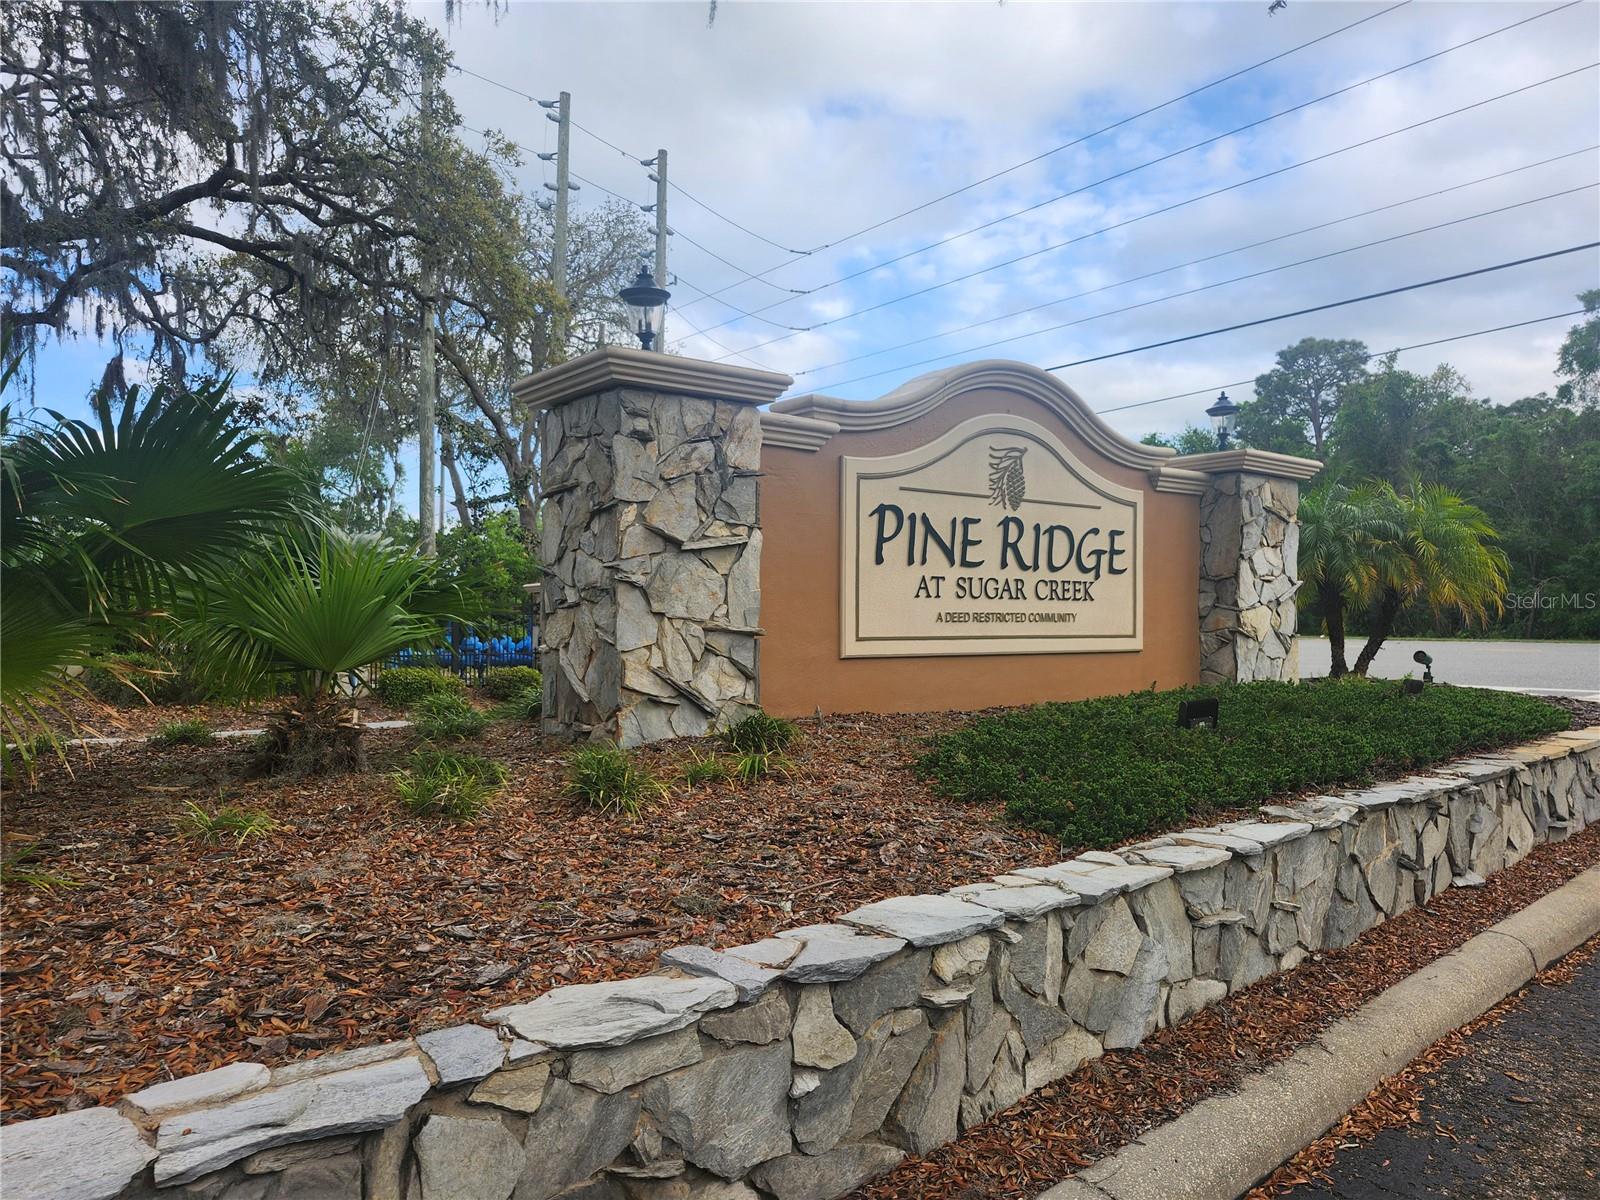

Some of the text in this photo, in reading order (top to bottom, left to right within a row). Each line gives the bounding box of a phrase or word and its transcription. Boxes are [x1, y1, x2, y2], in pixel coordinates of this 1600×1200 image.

[869, 503, 1128, 581] PINE RIDGE
[914, 575, 1095, 602] AT SUGAR CREEK
[936, 612, 1077, 624] A DEED RESTRICTED COMMUNITY
